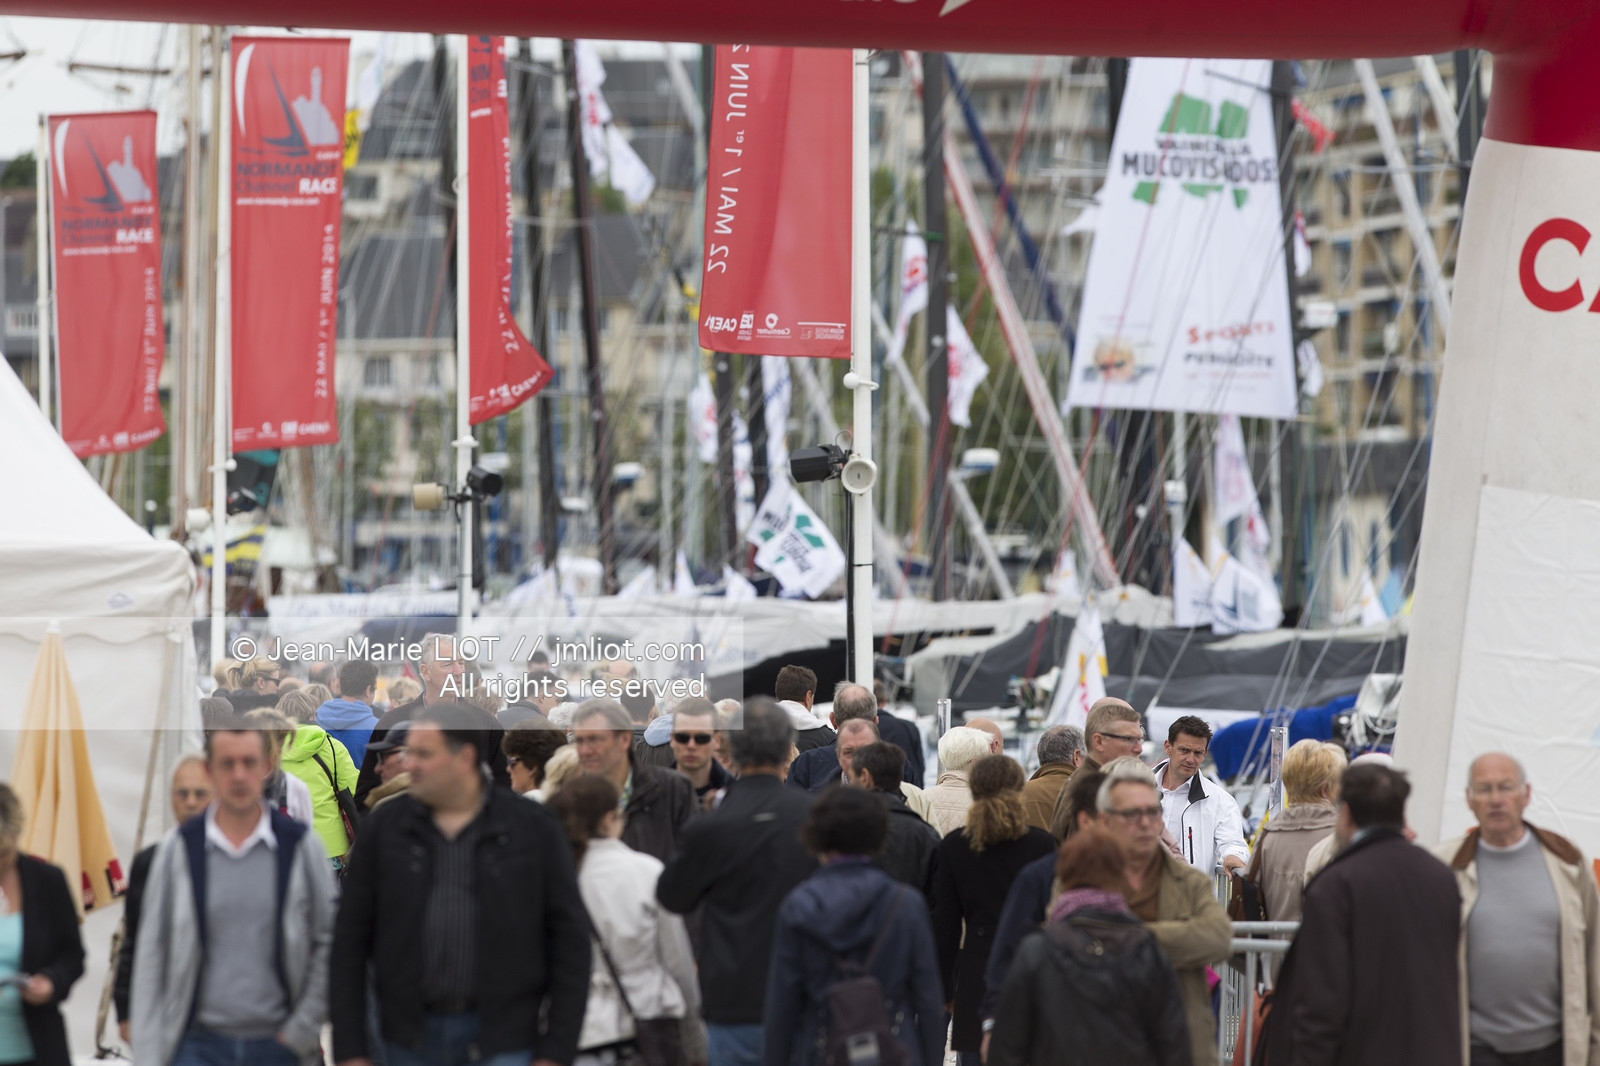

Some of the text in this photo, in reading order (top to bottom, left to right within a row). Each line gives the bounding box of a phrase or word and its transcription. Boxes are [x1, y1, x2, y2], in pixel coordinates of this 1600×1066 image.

[299, 177, 338, 194] RACE
[116, 228, 155, 243] RACE
[1518, 217, 1600, 313] C
